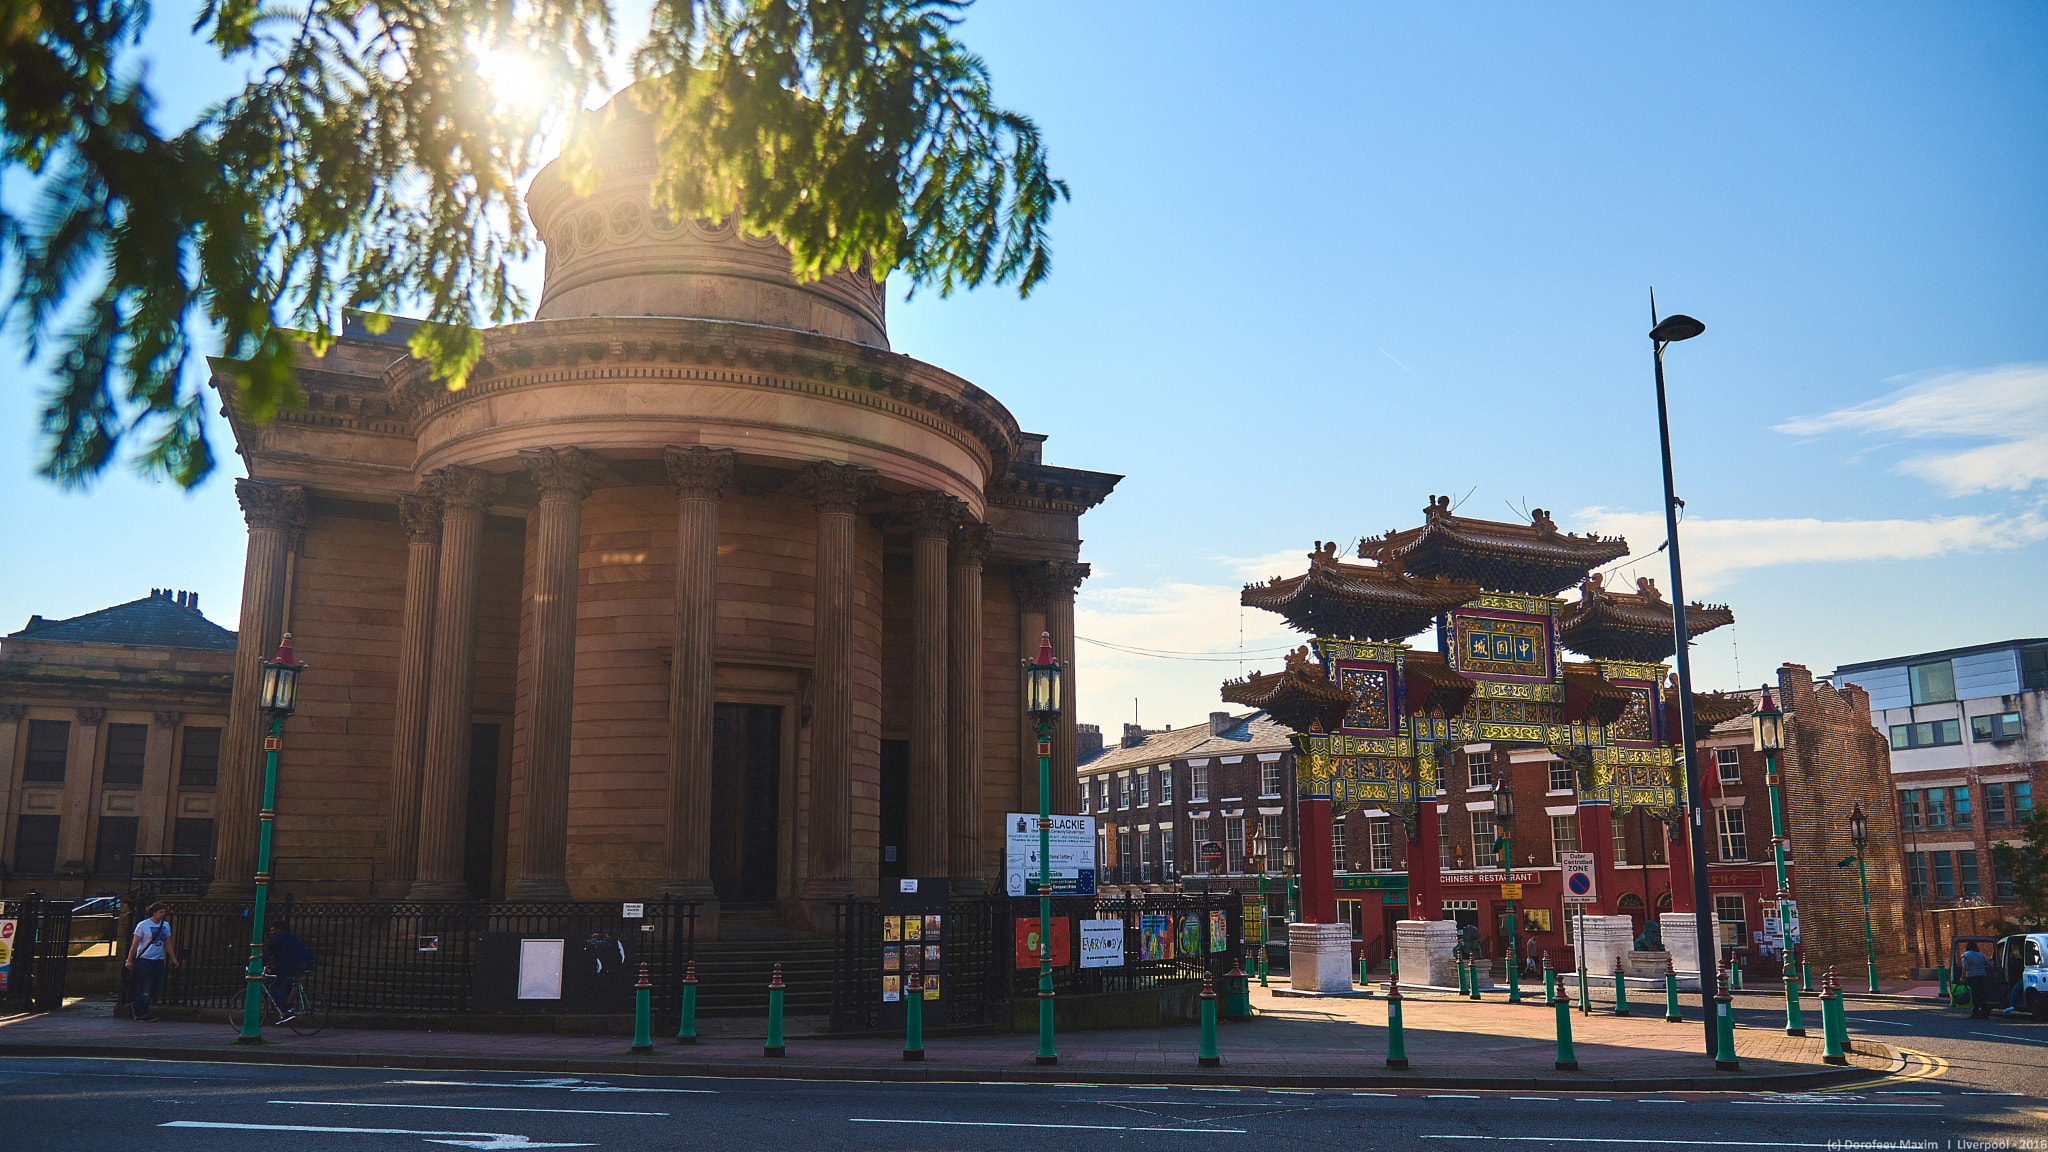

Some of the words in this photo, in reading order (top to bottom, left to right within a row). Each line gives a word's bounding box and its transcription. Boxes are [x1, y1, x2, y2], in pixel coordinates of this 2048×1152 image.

[1049, 819, 1085, 830] BLACKIE
[1440, 875, 1474, 883] CHINESE
[1082, 936, 1122, 952] EVERYBODY
